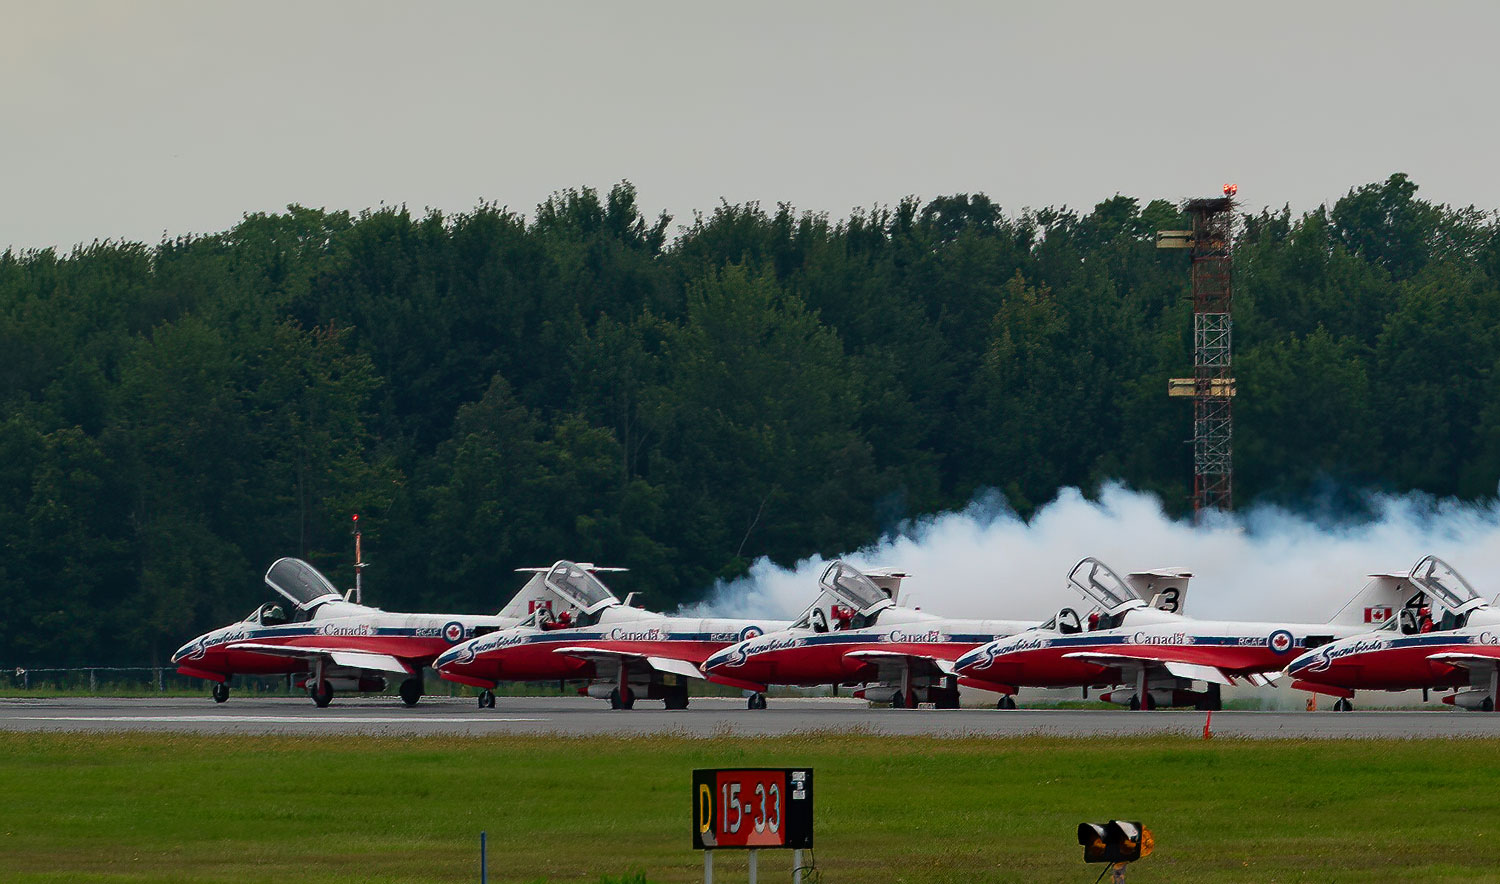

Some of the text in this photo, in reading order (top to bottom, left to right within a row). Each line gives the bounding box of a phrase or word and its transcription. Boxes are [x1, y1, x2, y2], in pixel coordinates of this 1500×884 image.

[1158, 588, 1180, 613] 3
[1406, 589, 1430, 616] 4
[323, 623, 369, 636] Canada
[611, 628, 658, 641] Canada
[889, 630, 939, 643] Canada
[1133, 631, 1183, 645] Canada
[191, 630, 245, 660] Snowbirds
[455, 634, 523, 664] Snowbirds
[728, 639, 796, 667] Snowbirds
[973, 638, 1042, 669] Snowbirds
[1308, 640, 1383, 672] Snowbirds
[700, 783, 712, 833] D
[722, 783, 780, 833] 15-33
